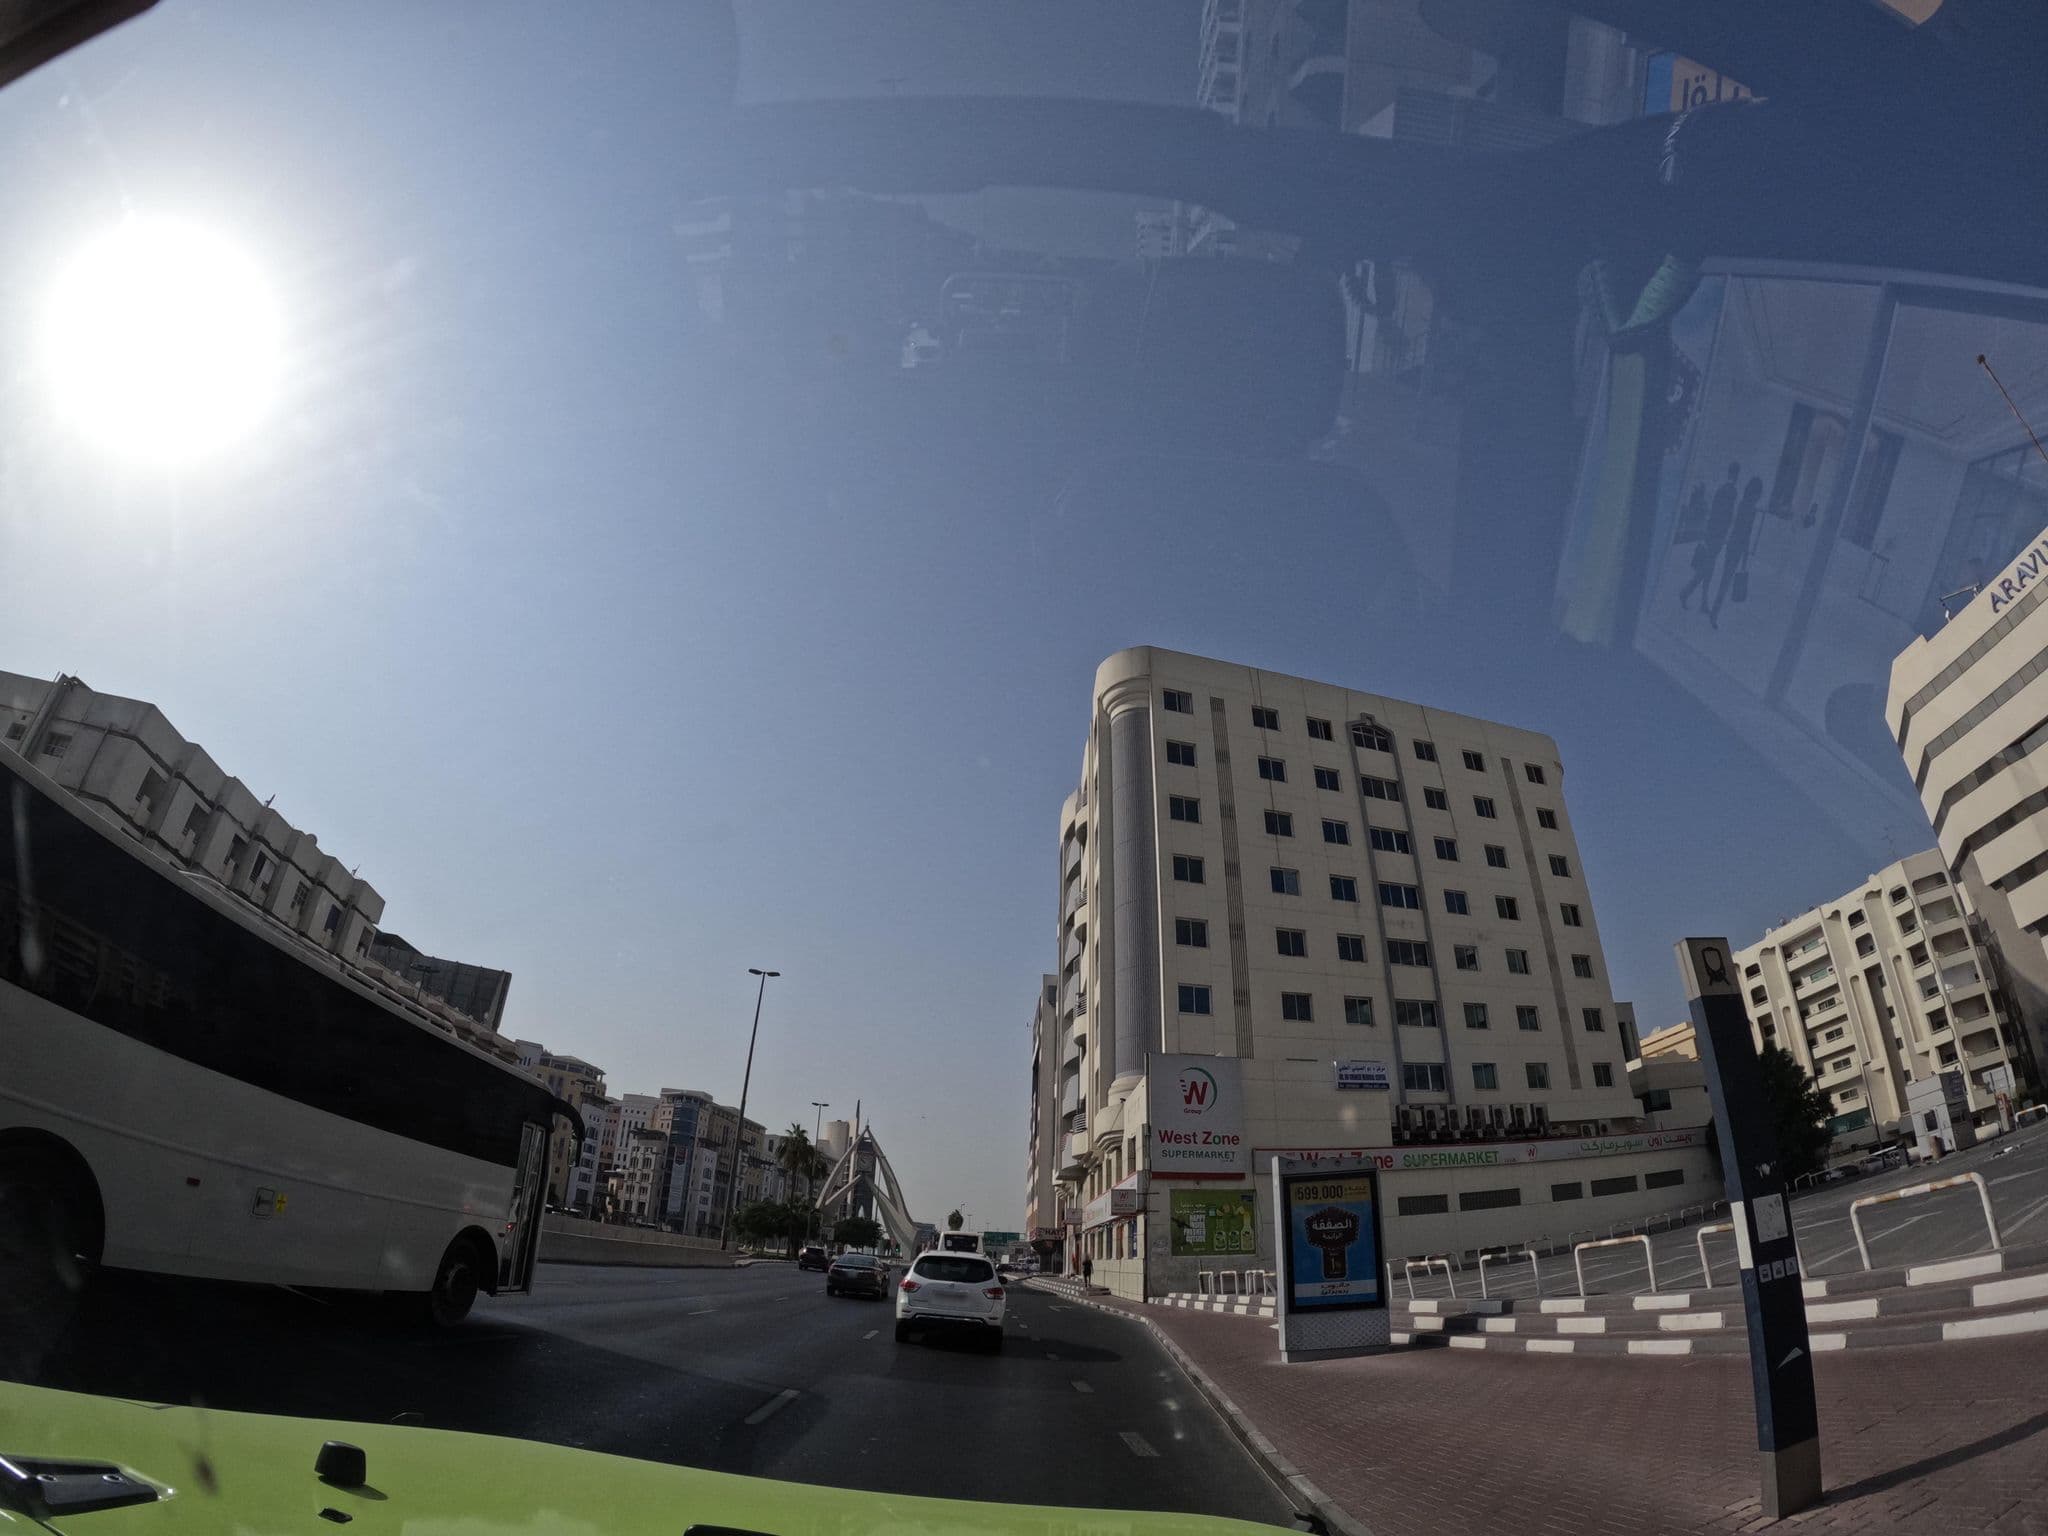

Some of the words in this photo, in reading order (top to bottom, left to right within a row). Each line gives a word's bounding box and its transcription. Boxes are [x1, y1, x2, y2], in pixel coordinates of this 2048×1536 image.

[1183, 1107, 1203, 1116] Group
[1158, 1129, 1199, 1145] West
[1202, 1130, 1240, 1146] Zone
[1161, 1149, 1236, 1161] SUPERMARKET
[1402, 1150, 1500, 1168] SUPERMARKET
[1312, 1218, 1353, 1231] الصفقة
